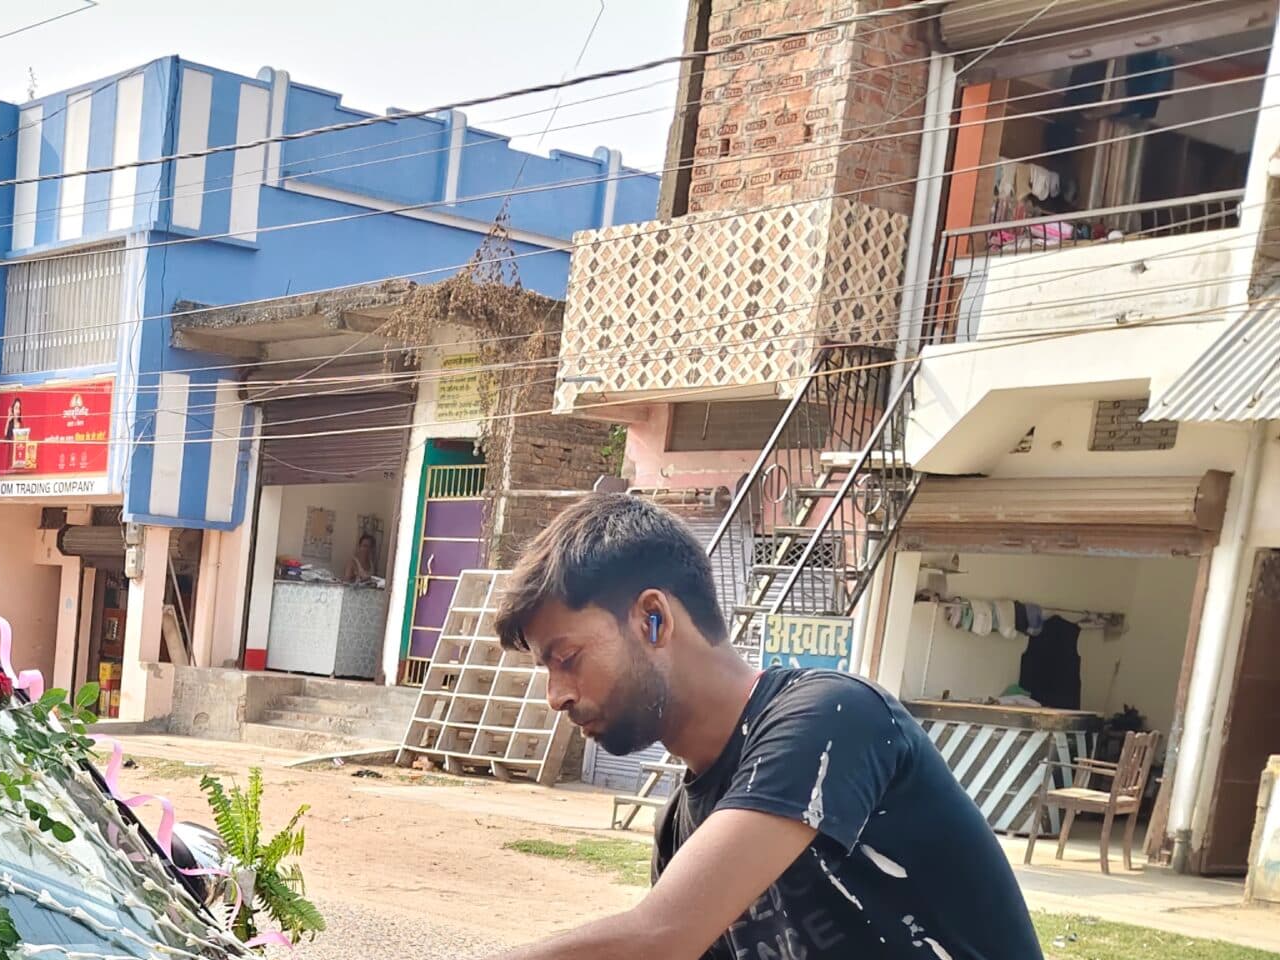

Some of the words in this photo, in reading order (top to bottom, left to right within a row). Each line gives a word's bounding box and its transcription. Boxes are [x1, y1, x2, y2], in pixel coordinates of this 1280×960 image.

[0, 483, 14, 495] OM
[16, 482, 51, 494] TRADING
[53, 480, 96, 493] COMPANY
